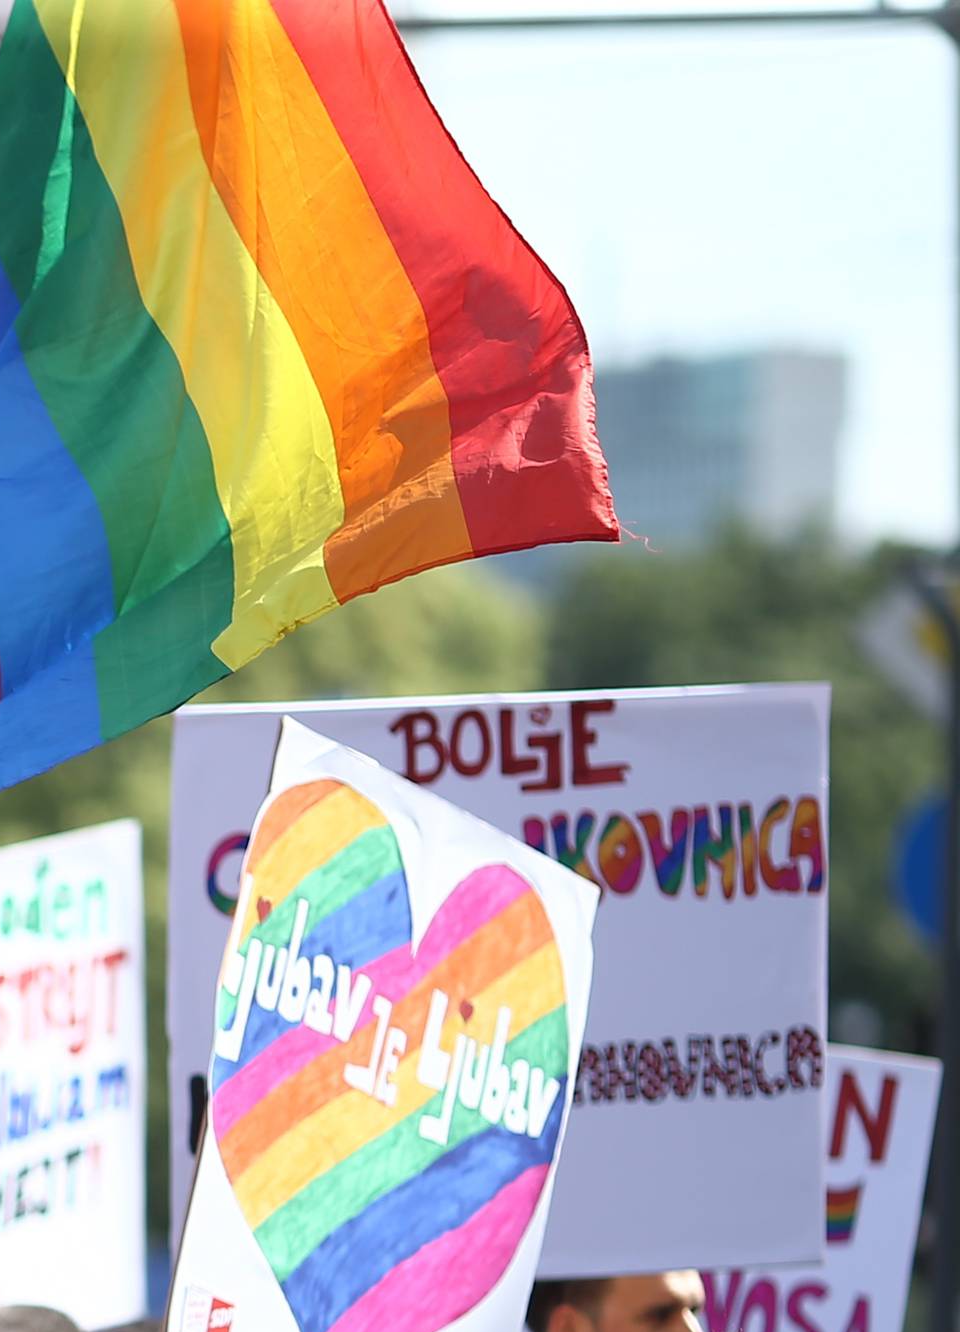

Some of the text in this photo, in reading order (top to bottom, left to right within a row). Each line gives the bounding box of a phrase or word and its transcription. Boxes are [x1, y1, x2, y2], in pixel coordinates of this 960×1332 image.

[388, 699, 631, 793] BOLJE
[214, 873, 373, 1062] Ljubav
[416, 988, 561, 1145] Ljubav
